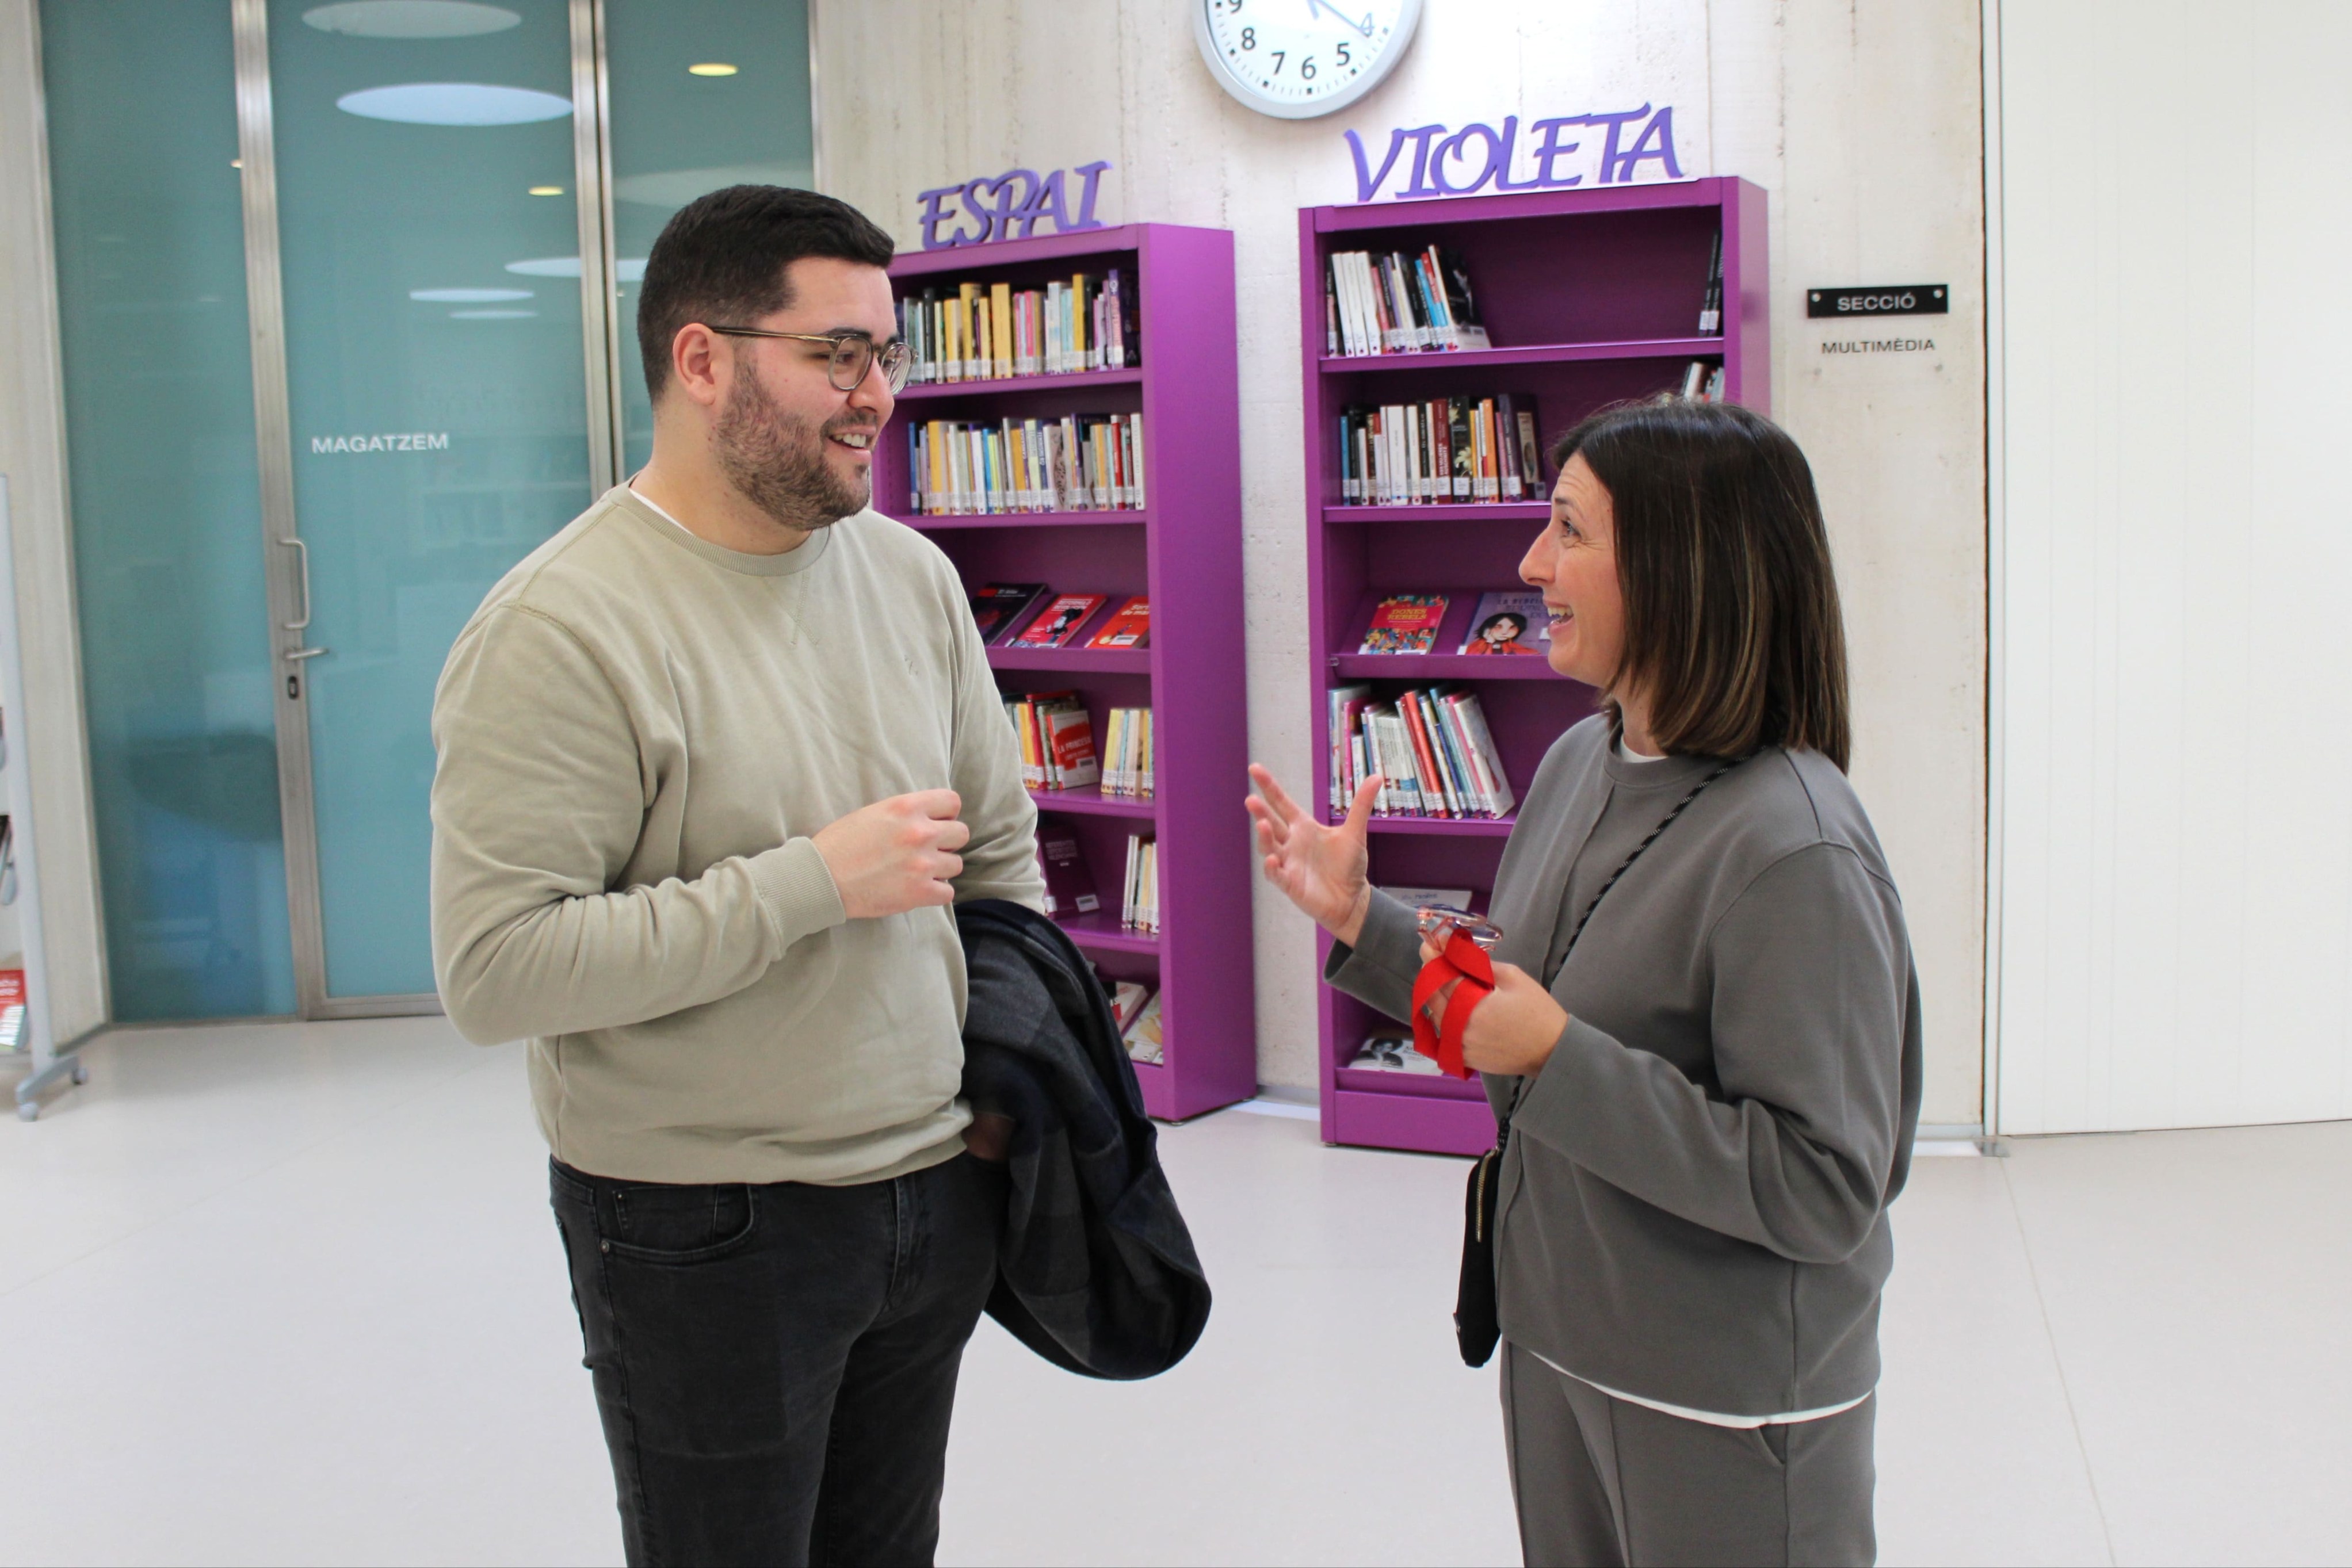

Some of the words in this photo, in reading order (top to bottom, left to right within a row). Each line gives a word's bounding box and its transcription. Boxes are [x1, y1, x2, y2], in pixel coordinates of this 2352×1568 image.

[1358, 13, 1374, 37] 4
[1241, 27, 1256, 51] 8
[1271, 51, 1285, 75] 7
[1336, 43, 1350, 67] 5
[1301, 56, 1316, 79] 6
[1343, 102, 1686, 203] VIOLETA
[917, 160, 1114, 251] ESPAI
[1837, 292, 1916, 311] SECCIÓ
[1821, 338, 1935, 354] MULTIMÈDIA
[311, 433, 448, 454] MAGATZEM
